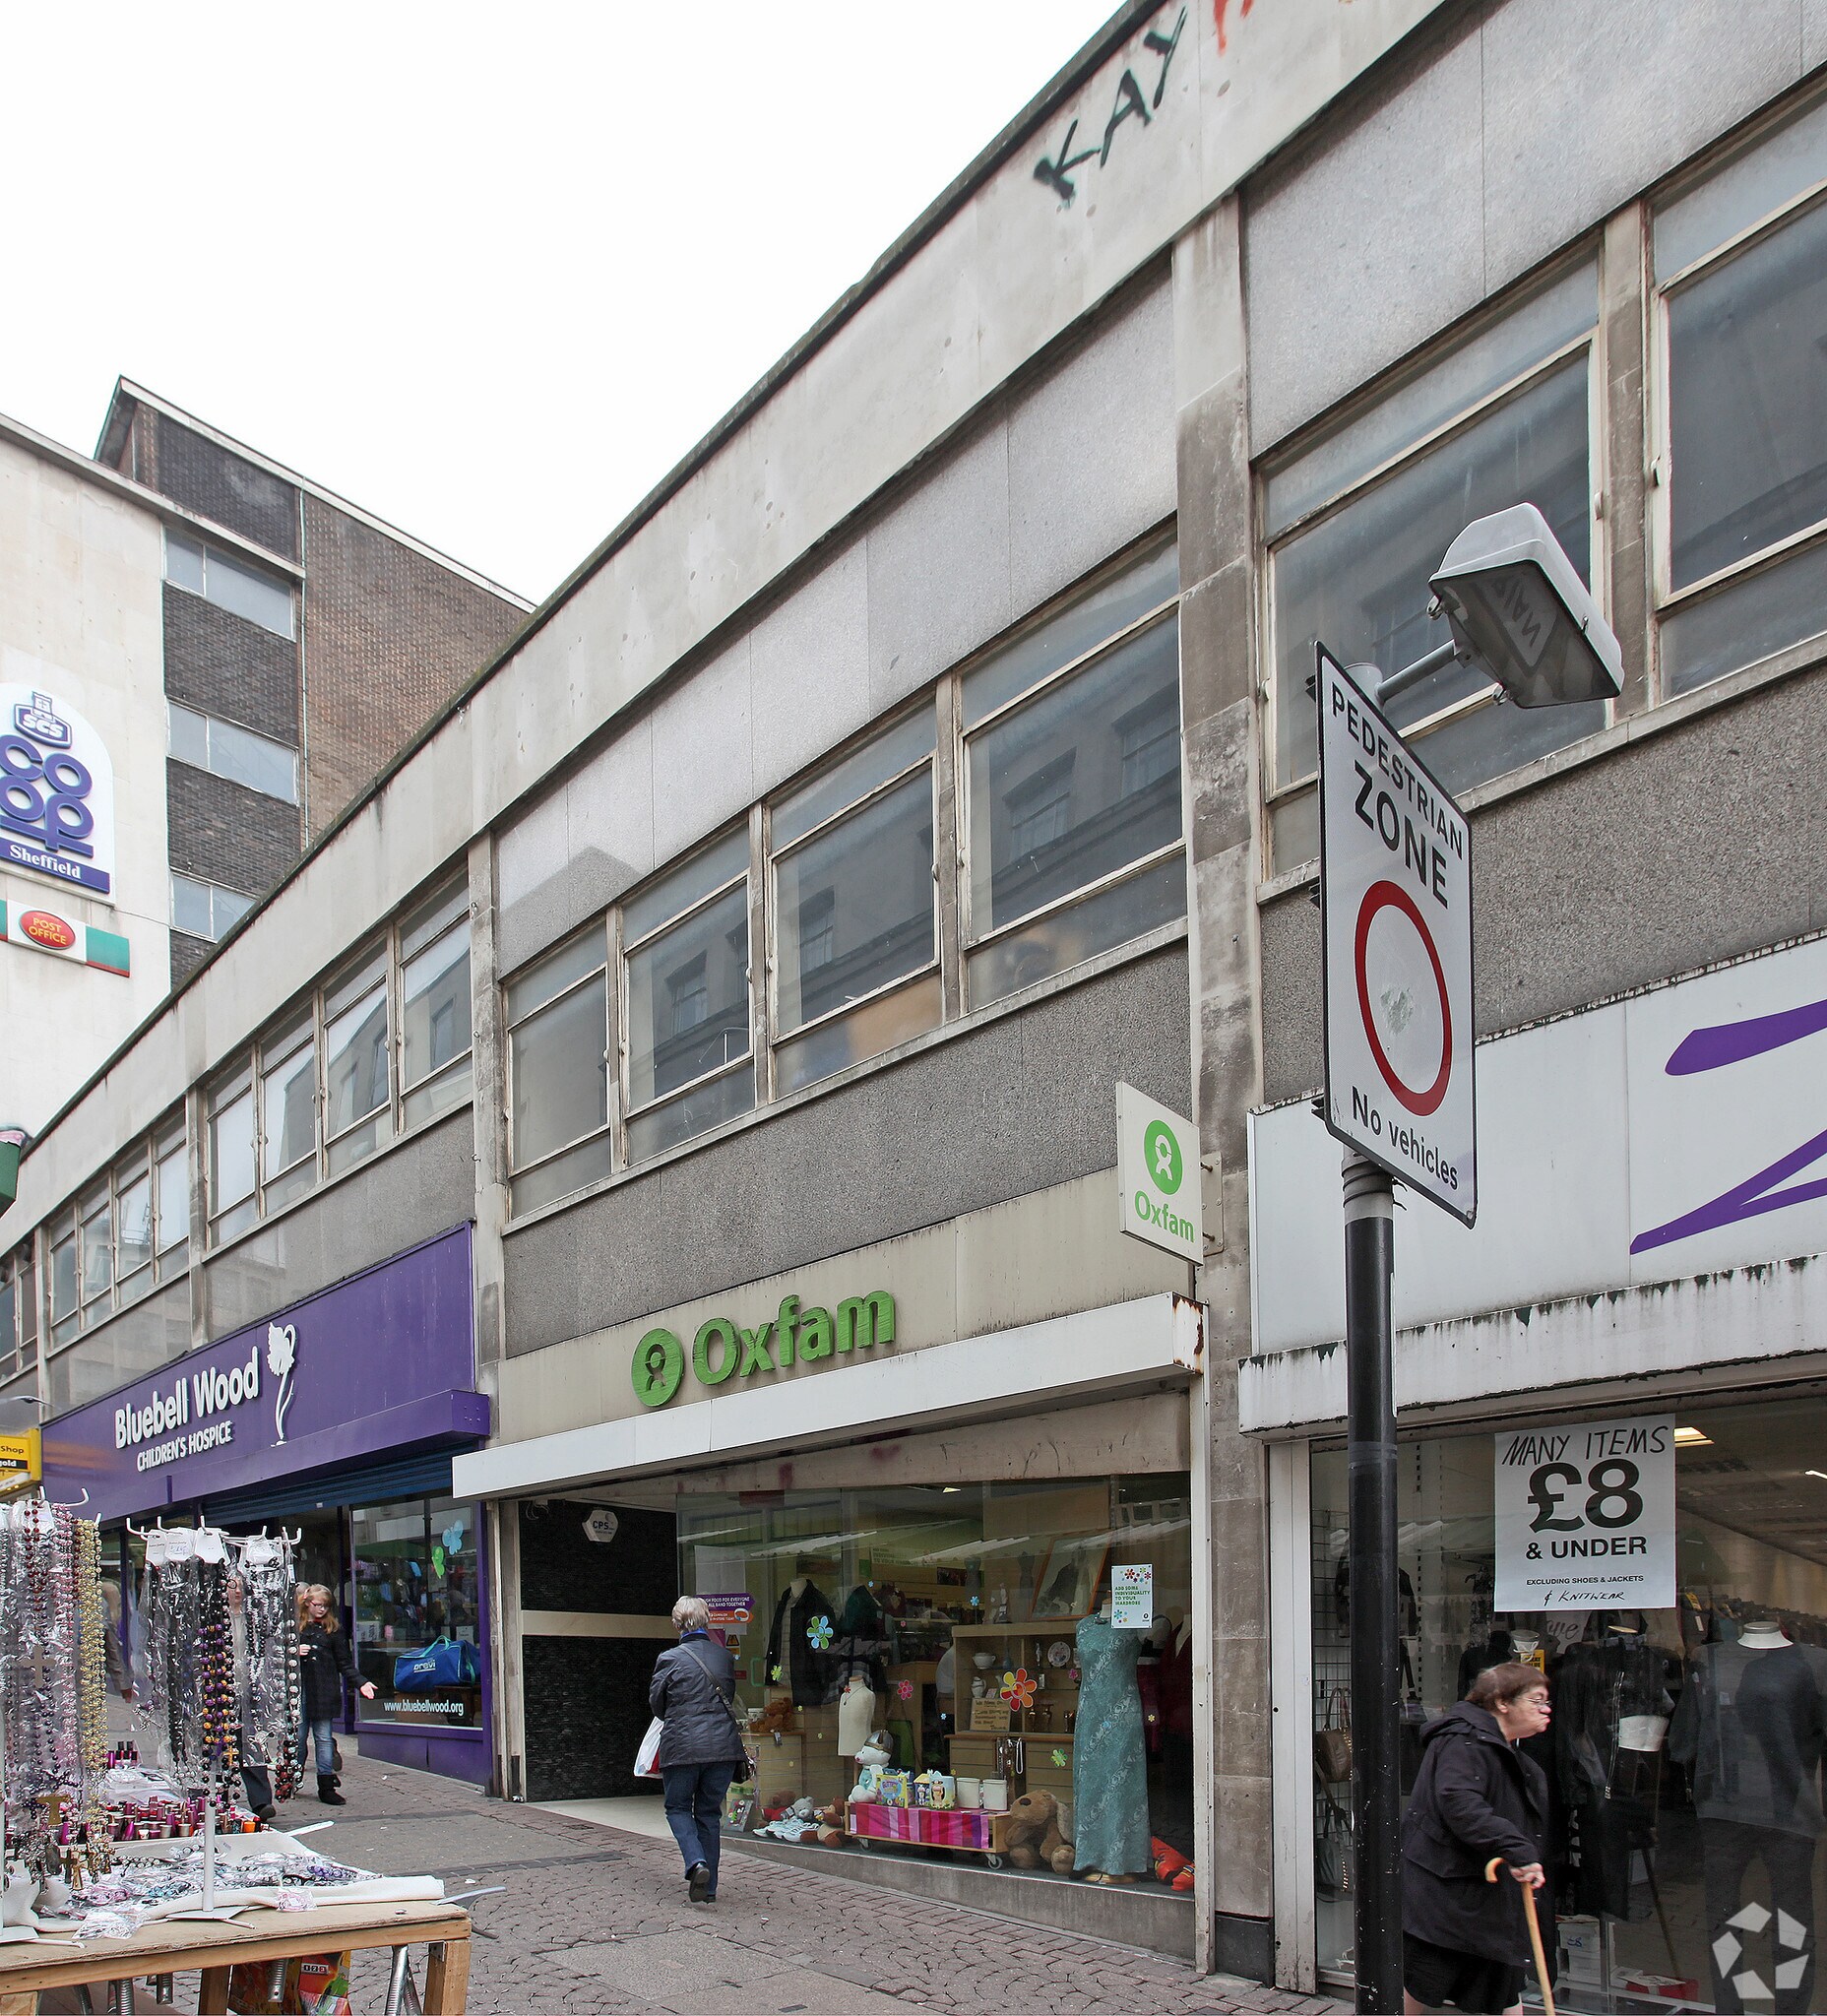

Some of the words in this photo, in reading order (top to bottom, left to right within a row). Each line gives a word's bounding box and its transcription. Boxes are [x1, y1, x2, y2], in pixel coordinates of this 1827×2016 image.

[1033, 6, 1187, 205] KAY
[1332, 681, 1463, 860] PEDESTRIAN
[1354, 759, 1448, 910] ZONE
[9, 844, 82, 880] Sheffield
[28, 925, 67, 945] OFFICE
[32, 916, 62, 932] POST
[1352, 1085, 1382, 1136] No
[1388, 1119, 1459, 1190] vehicles
[1134, 1190, 1195, 1243] Oxfam
[692, 1290, 896, 1385] Oxfam
[114, 1376, 190, 1449] Bluebell
[193, 1346, 260, 1418] Wood
[1, 1445, 25, 1454] Shop
[136, 1435, 187, 1473] CHILDREN'S
[188, 1419, 234, 1455] HOSPICE
[1501, 1434, 1571, 1466] MANY
[1585, 1425, 1670, 1460] ITEMS
[1527, 1458, 1644, 1533] £8
[1526, 1542, 1544, 1560] &
[1550, 1536, 1647, 1559] UNDER
[1558, 1590, 1625, 1602] KNITWEAR
[383, 1699, 464, 1716] www.bluebellwood.org
